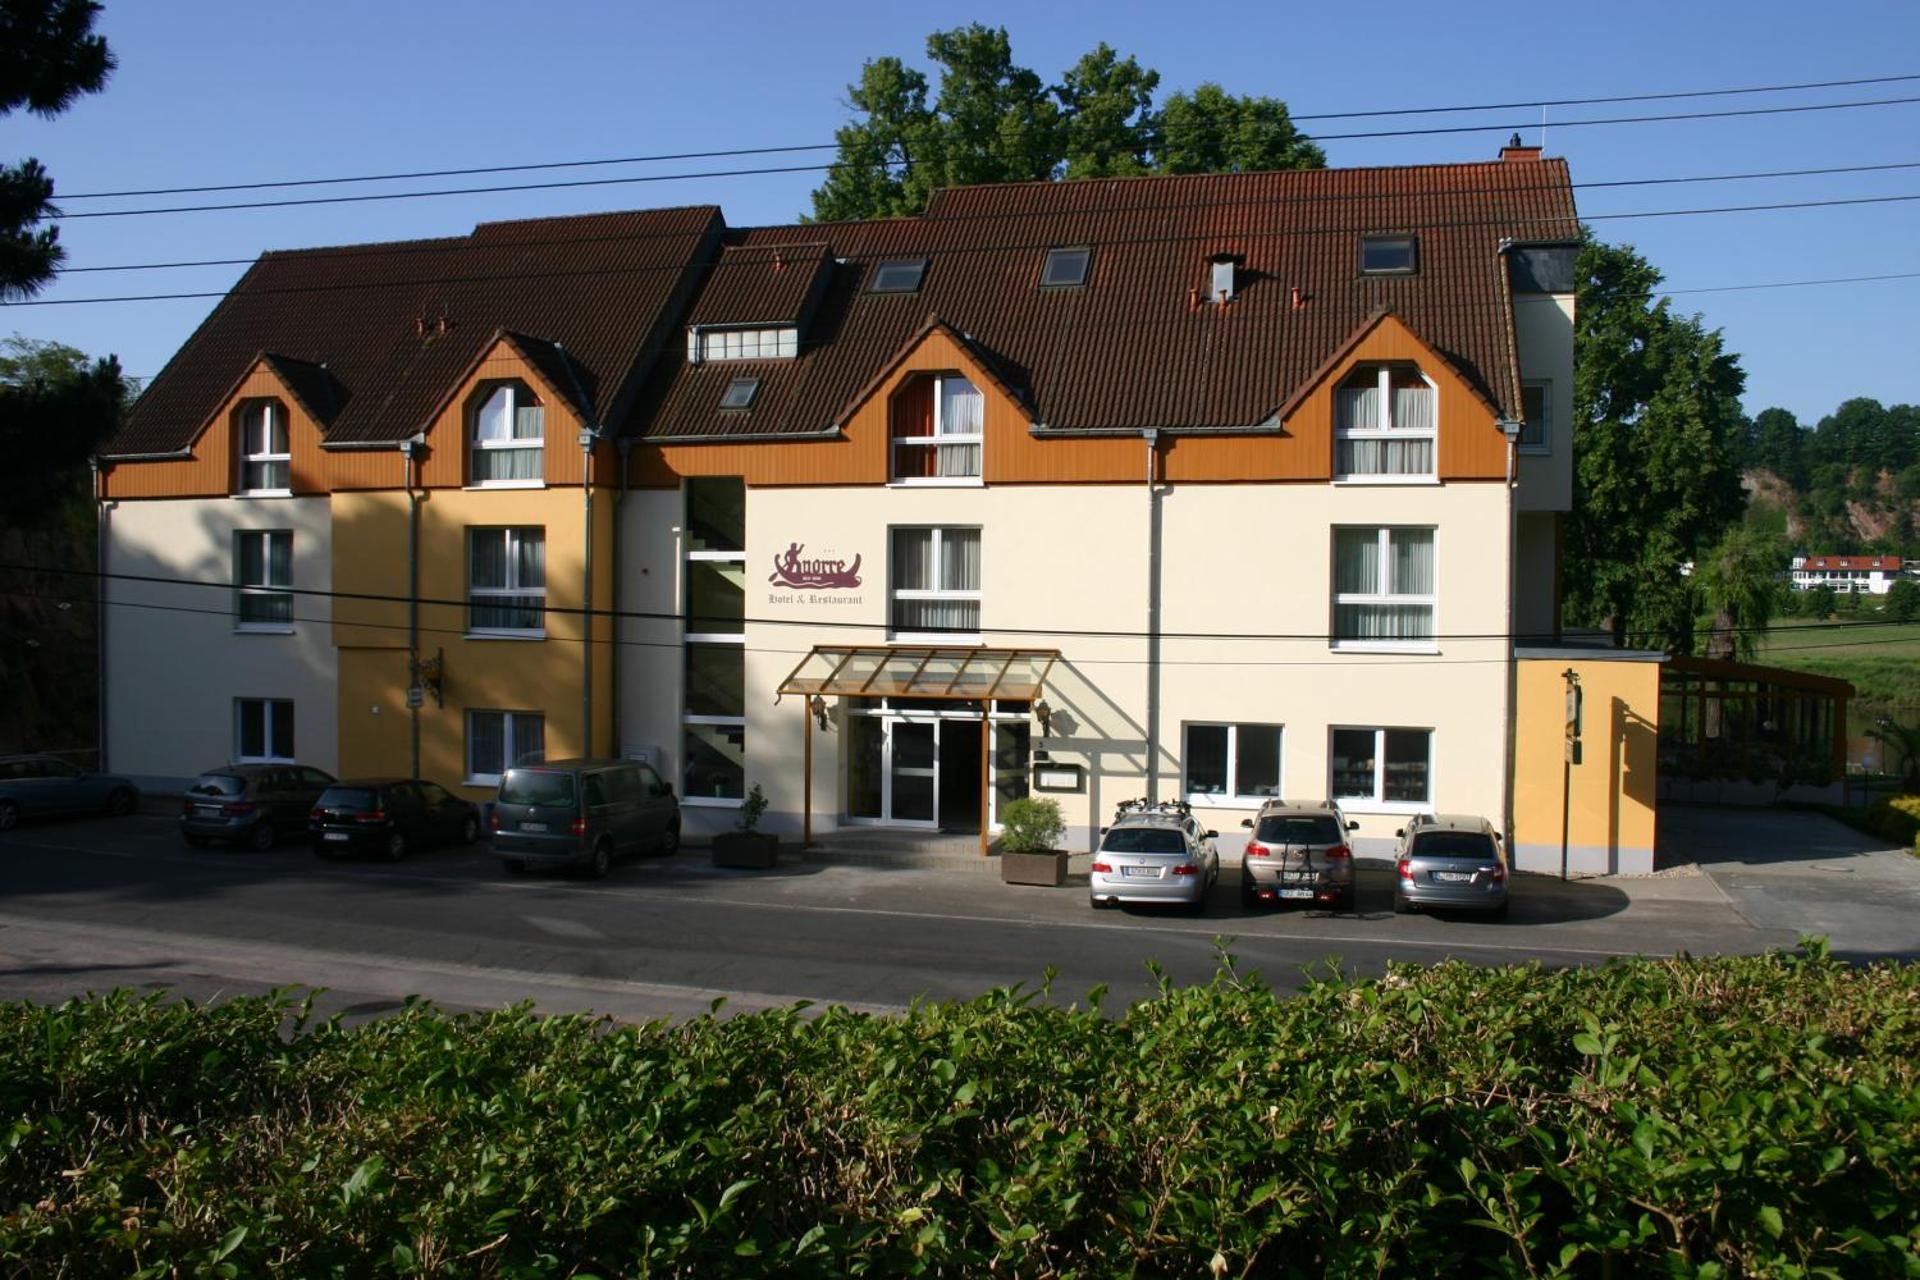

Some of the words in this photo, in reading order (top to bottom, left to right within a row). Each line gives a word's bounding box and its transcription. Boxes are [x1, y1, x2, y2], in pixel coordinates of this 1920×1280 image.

[769, 594, 794, 604] Hotel
[796, 594, 806, 604] &
[808, 594, 863, 605] Restaurant
